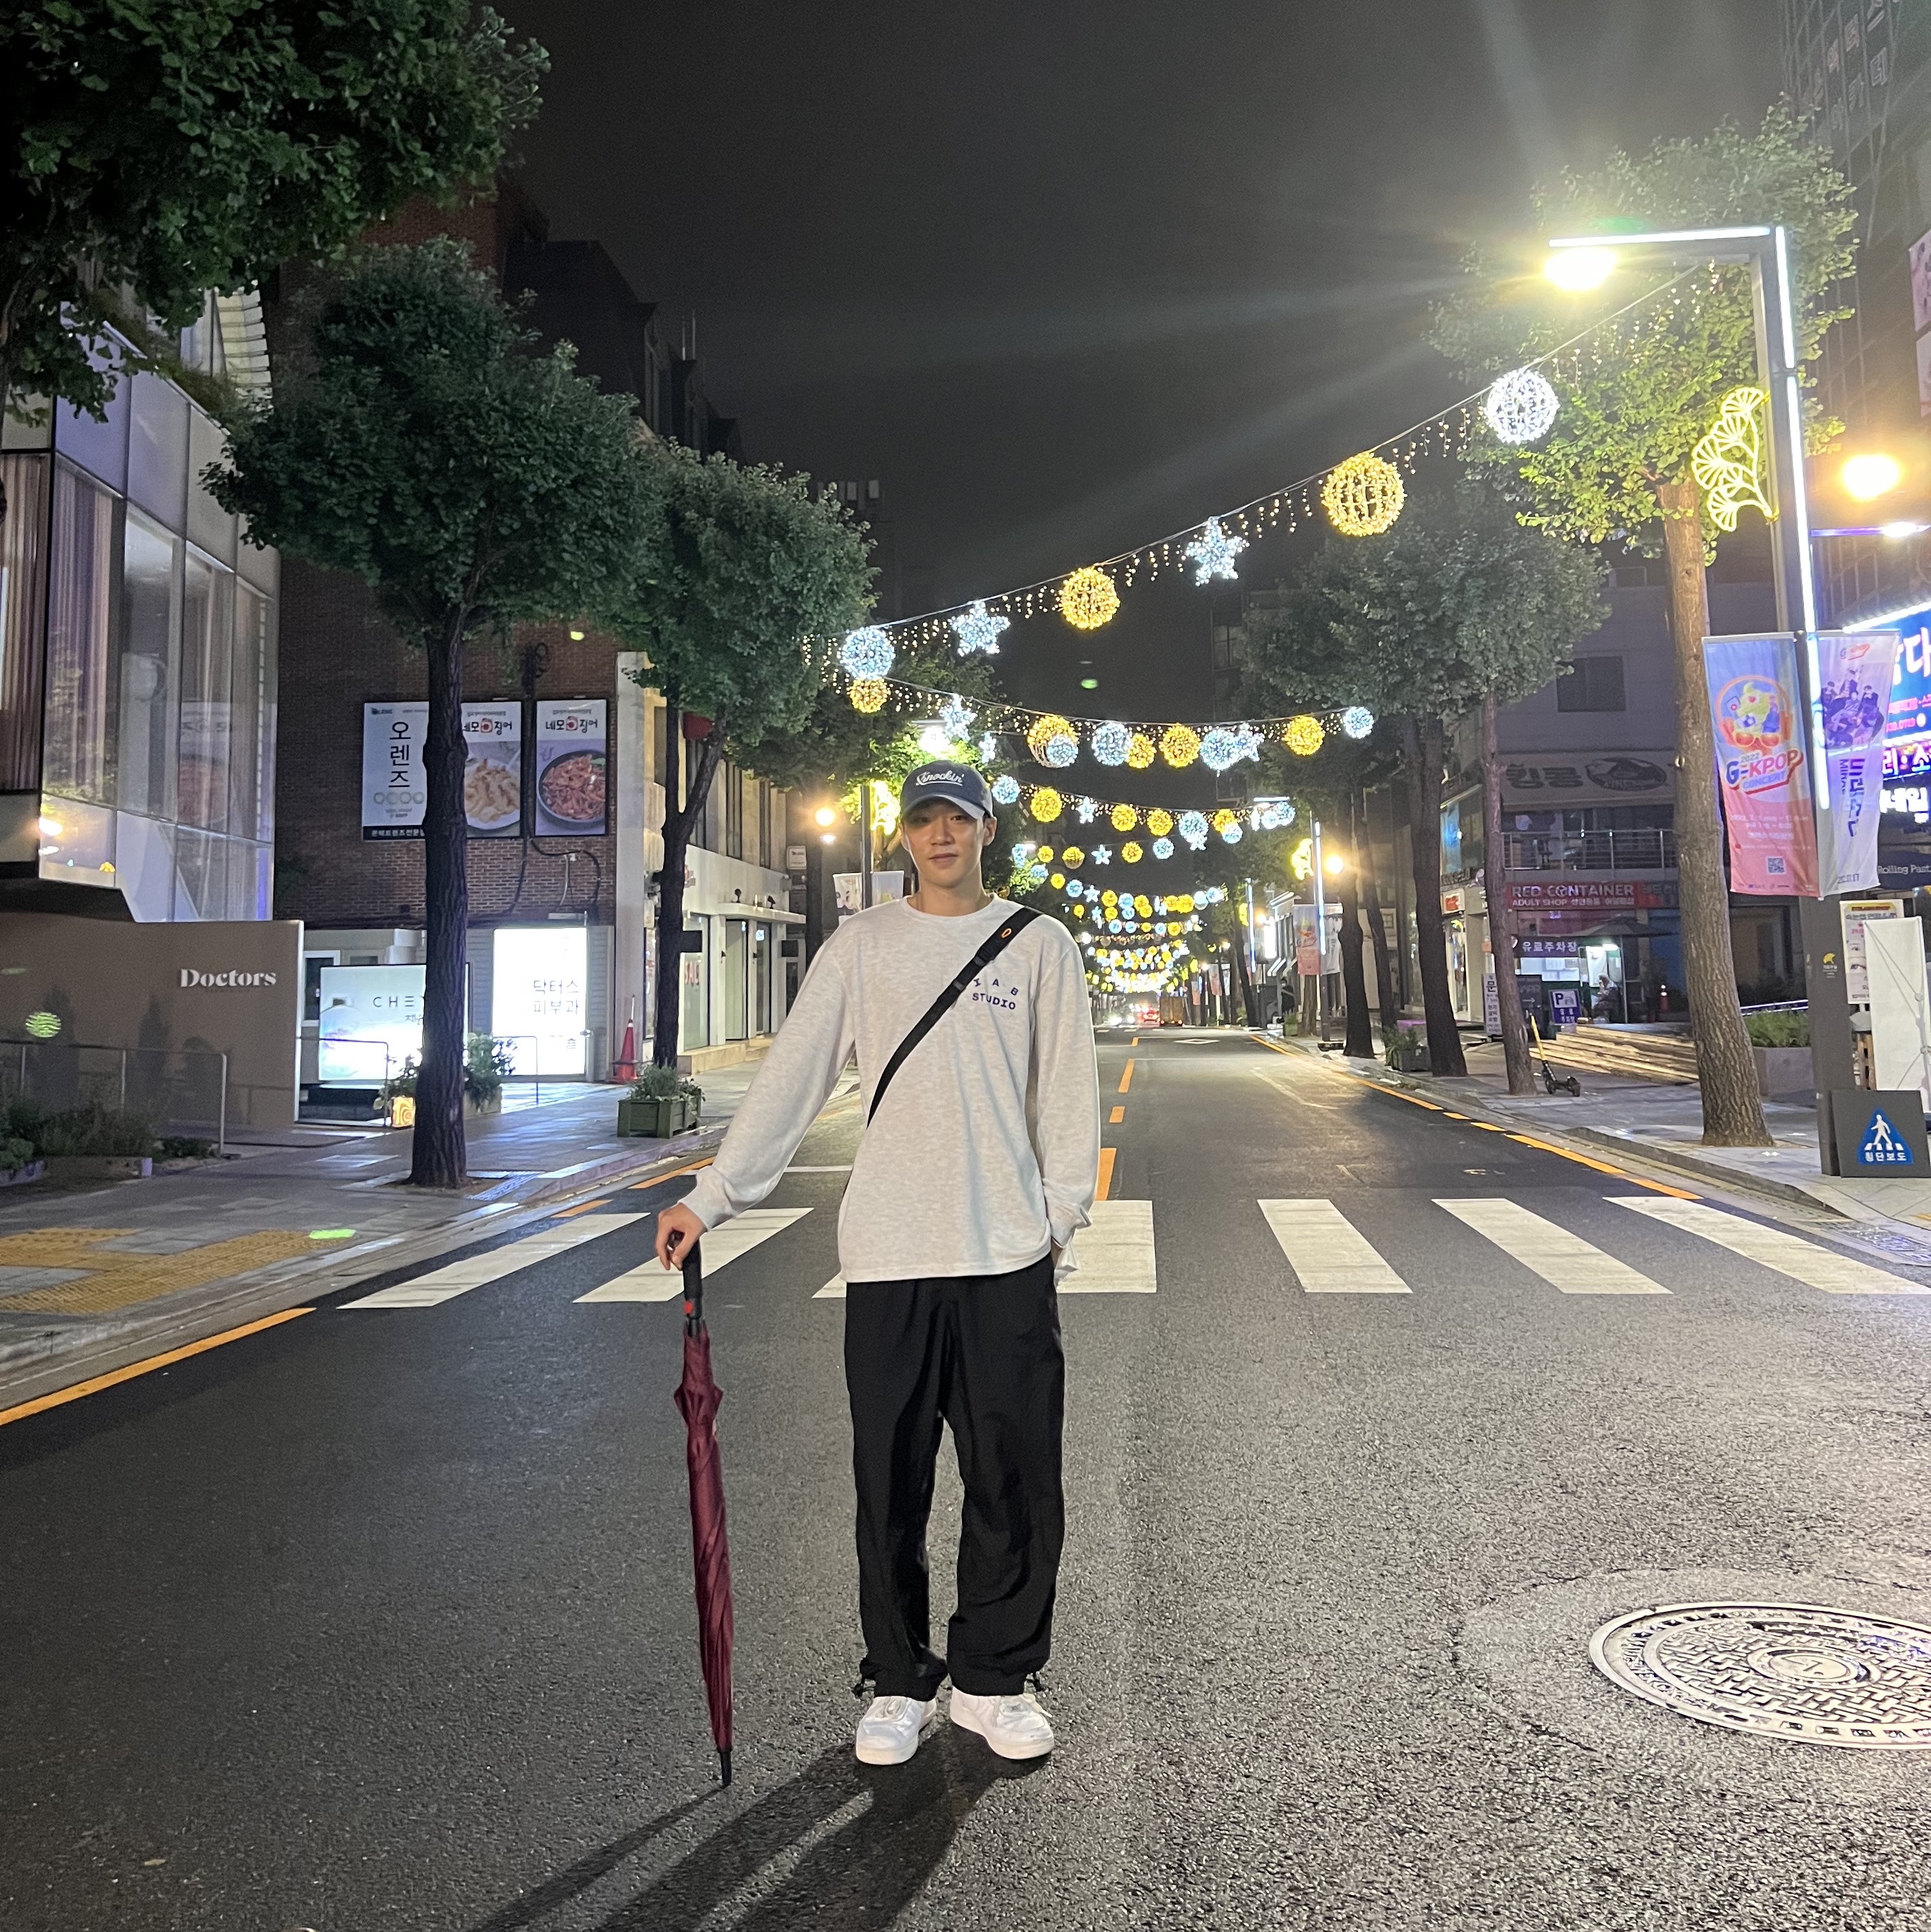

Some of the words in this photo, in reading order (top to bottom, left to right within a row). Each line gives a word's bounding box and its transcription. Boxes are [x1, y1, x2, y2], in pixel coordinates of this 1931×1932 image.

[388, 721, 411, 788] 오렌즈
[1726, 749, 1800, 785] G-KPOP
[1878, 865, 1909, 875] Rolling
[1512, 885, 1541, 898] RED
[1546, 884, 1634, 897] CONTAINER
[1543, 898, 1568, 906] SHOP
[1522, 941, 1577, 952] 유료주차장
[180, 968, 277, 987] Doctors
[533, 979, 579, 996] 닥터스
[972, 993, 1016, 1010] STUDIO
[1555, 993, 1564, 1005] P
[533, 999, 579, 1015] 피부과
[1865, 1152, 1907, 1162] 횡단보도
